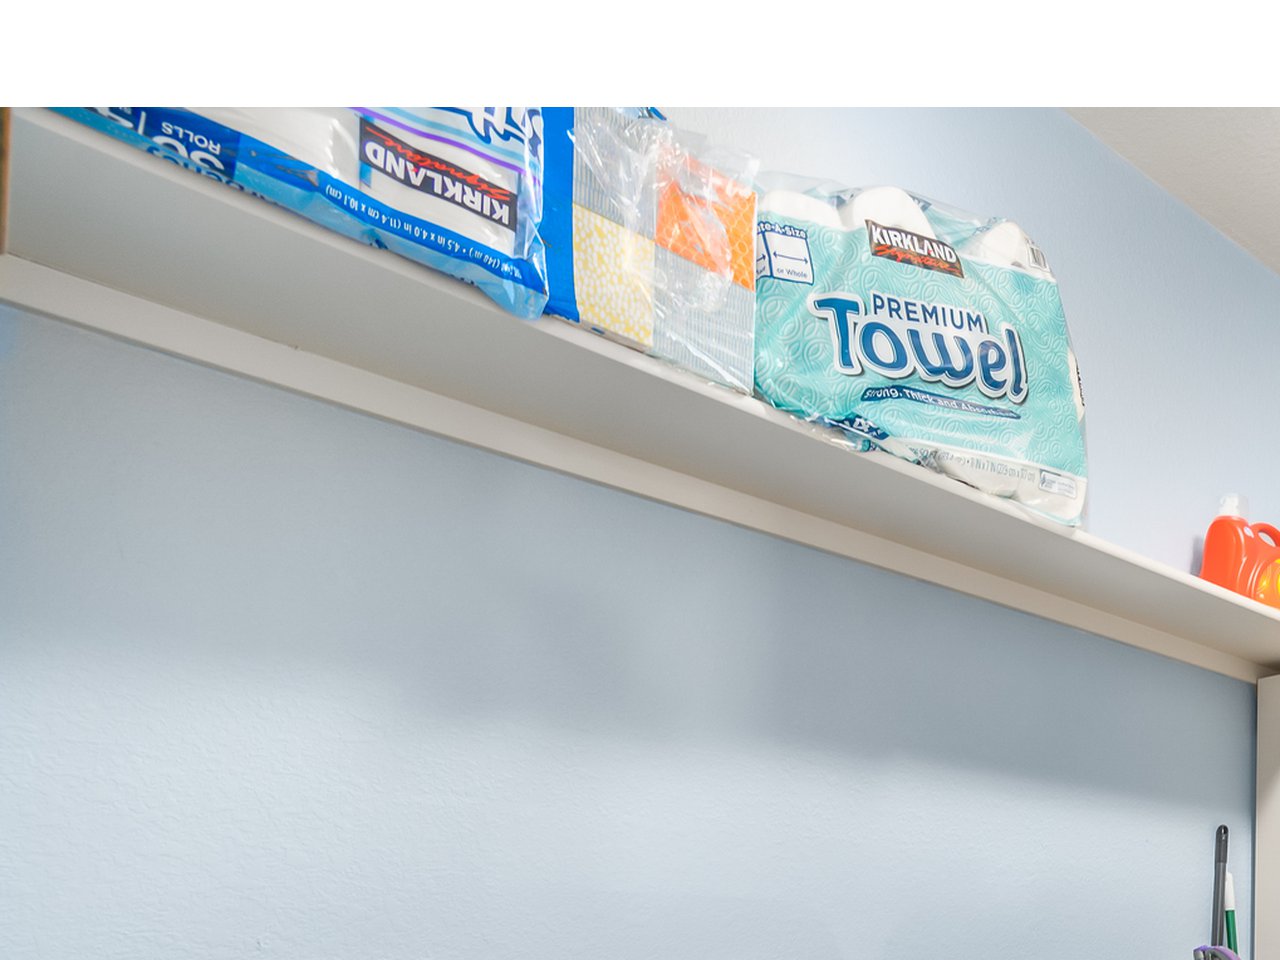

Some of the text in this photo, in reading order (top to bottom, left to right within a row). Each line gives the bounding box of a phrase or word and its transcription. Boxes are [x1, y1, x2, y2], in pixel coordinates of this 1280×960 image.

[161, 121, 221, 155] ROLLS
[364, 140, 519, 225] KIRKLAND
[871, 225, 957, 264] KIRKLAND
[872, 293, 983, 333] PREMIUM
[814, 297, 1024, 396] Towel
[937, 399, 957, 410] and
